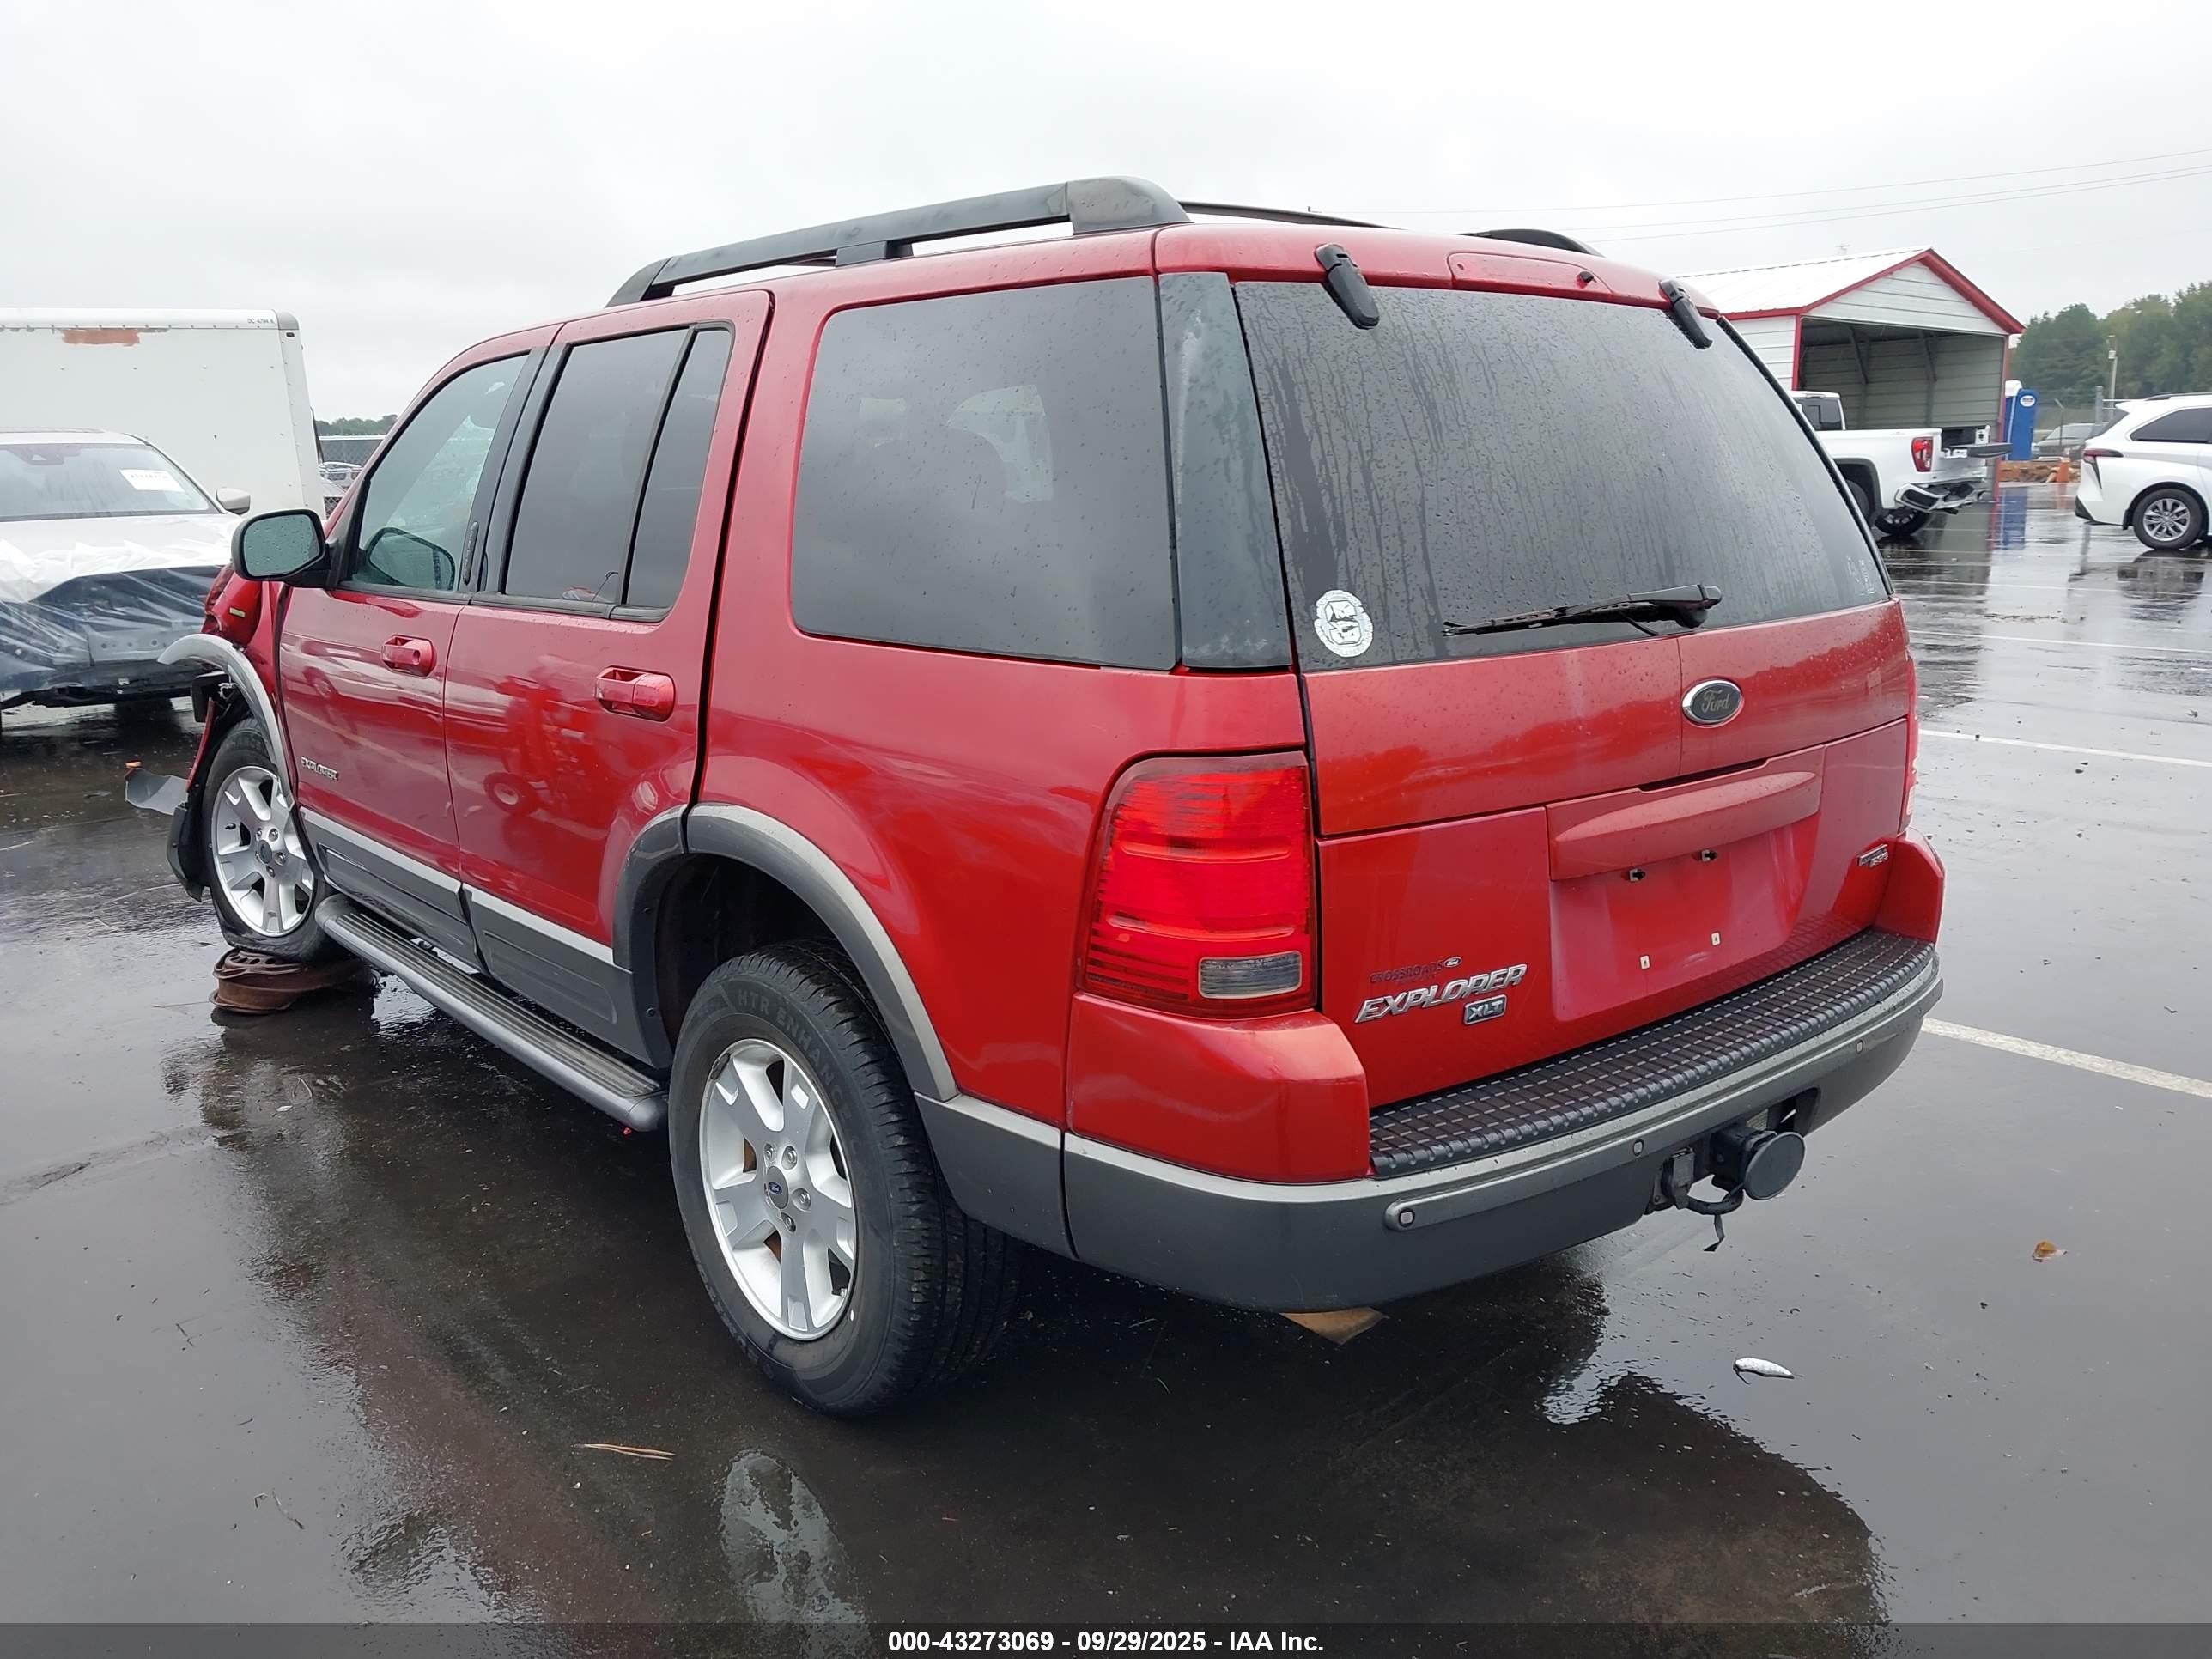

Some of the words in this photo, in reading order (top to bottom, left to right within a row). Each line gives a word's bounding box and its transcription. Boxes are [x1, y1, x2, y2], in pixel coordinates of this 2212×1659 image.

[1701, 689, 1731, 714] Ford
[738, 989, 770, 1015] HTR
[1354, 963, 1528, 1024] EXPLORER
[1468, 1001, 1504, 1020] XLT
